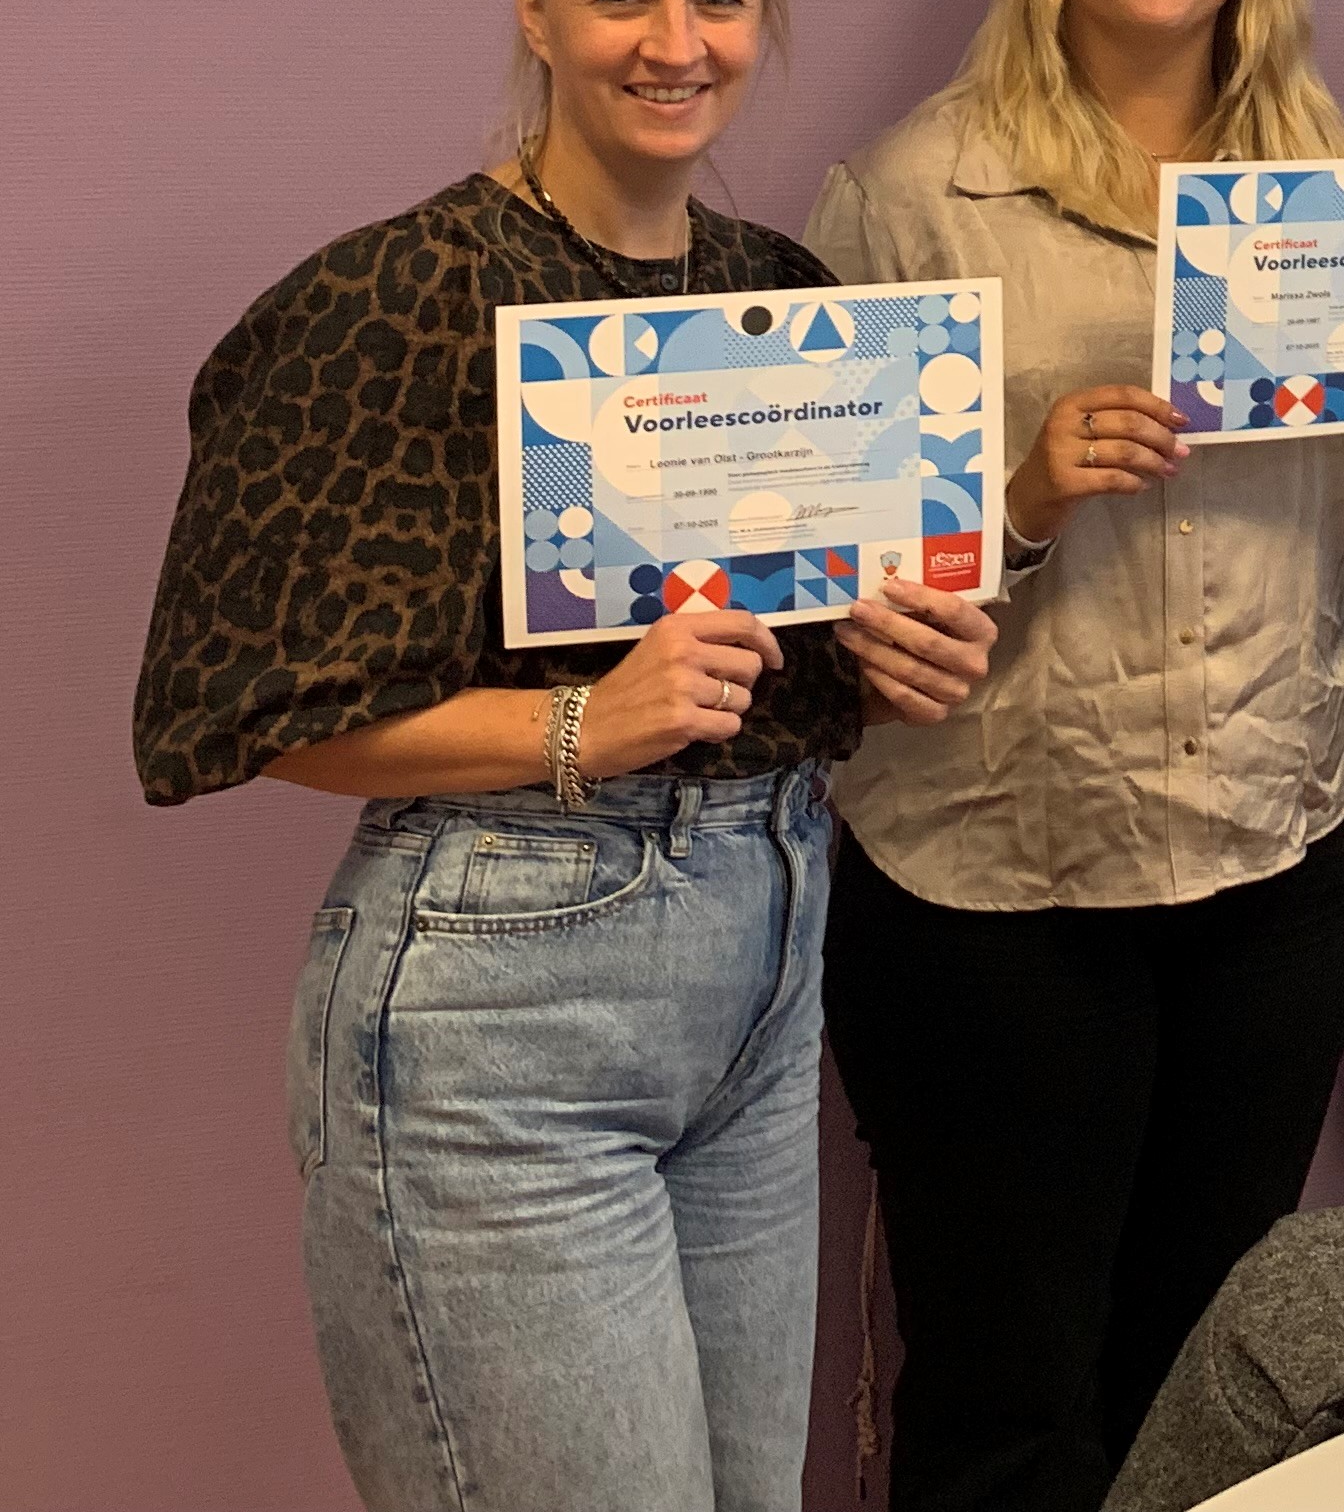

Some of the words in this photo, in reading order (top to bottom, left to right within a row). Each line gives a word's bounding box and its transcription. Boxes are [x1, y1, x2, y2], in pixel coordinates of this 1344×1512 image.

[1253, 237, 1318, 251] Certificaat
[623, 391, 709, 409] Certificaat
[623, 399, 884, 434] Voorleescoördinator
[649, 457, 688, 469] Leonie
[690, 455, 711, 465] van
[713, 453, 737, 464] Olst
